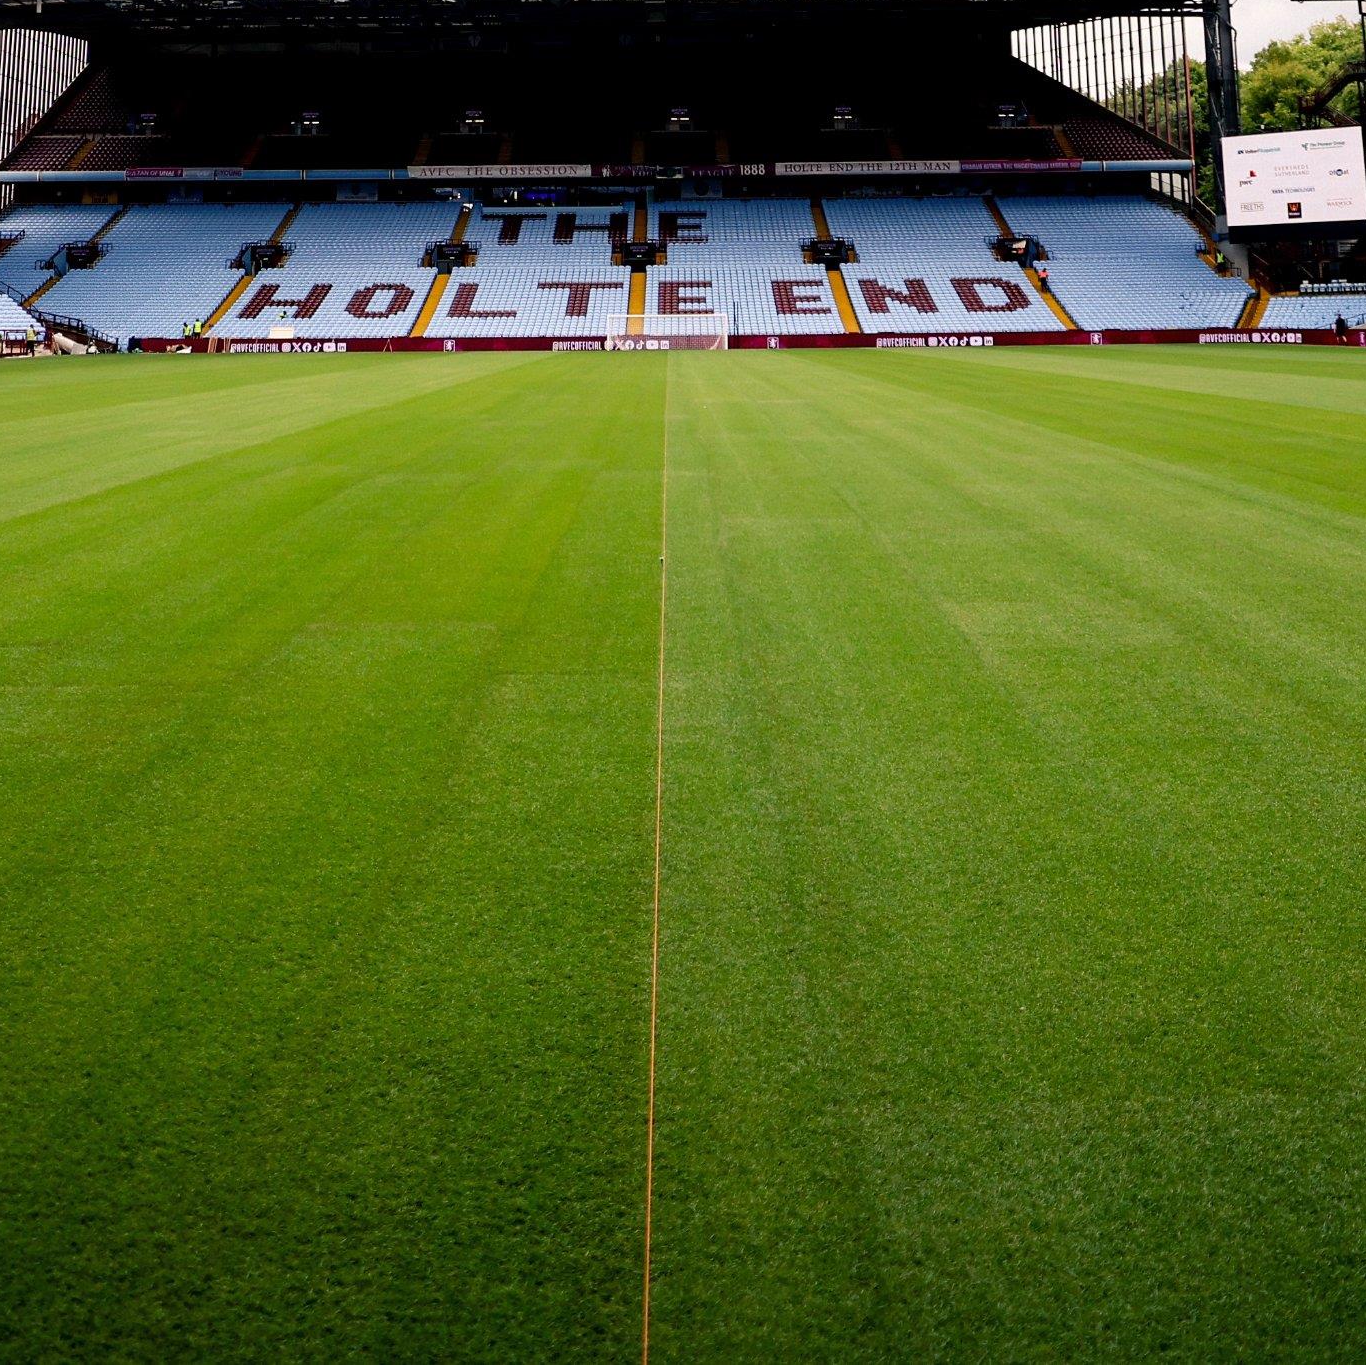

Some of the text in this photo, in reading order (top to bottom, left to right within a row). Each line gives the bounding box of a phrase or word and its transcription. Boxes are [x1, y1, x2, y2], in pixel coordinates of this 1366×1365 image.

[419, 165, 579, 177] AVFC THE OBSESSION
[739, 164, 766, 176] 1888
[784, 163, 822, 173] HOLTE
[829, 163, 854, 172] END
[858, 163, 883, 172] THE
[889, 162, 918, 172] 12TH
[923, 162, 952, 172] MAN
[482, 212, 708, 245] THE
[238, 277, 1032, 319] HOLTE END
[876, 337, 927, 348] @AVFCOFFICIAL
[1198, 333, 1251, 344] @AVFCOFFICIAL
[229, 342, 280, 354] @AVFCOFFICIAL
[552, 340, 603, 351] @AVFCOFFICIAL
